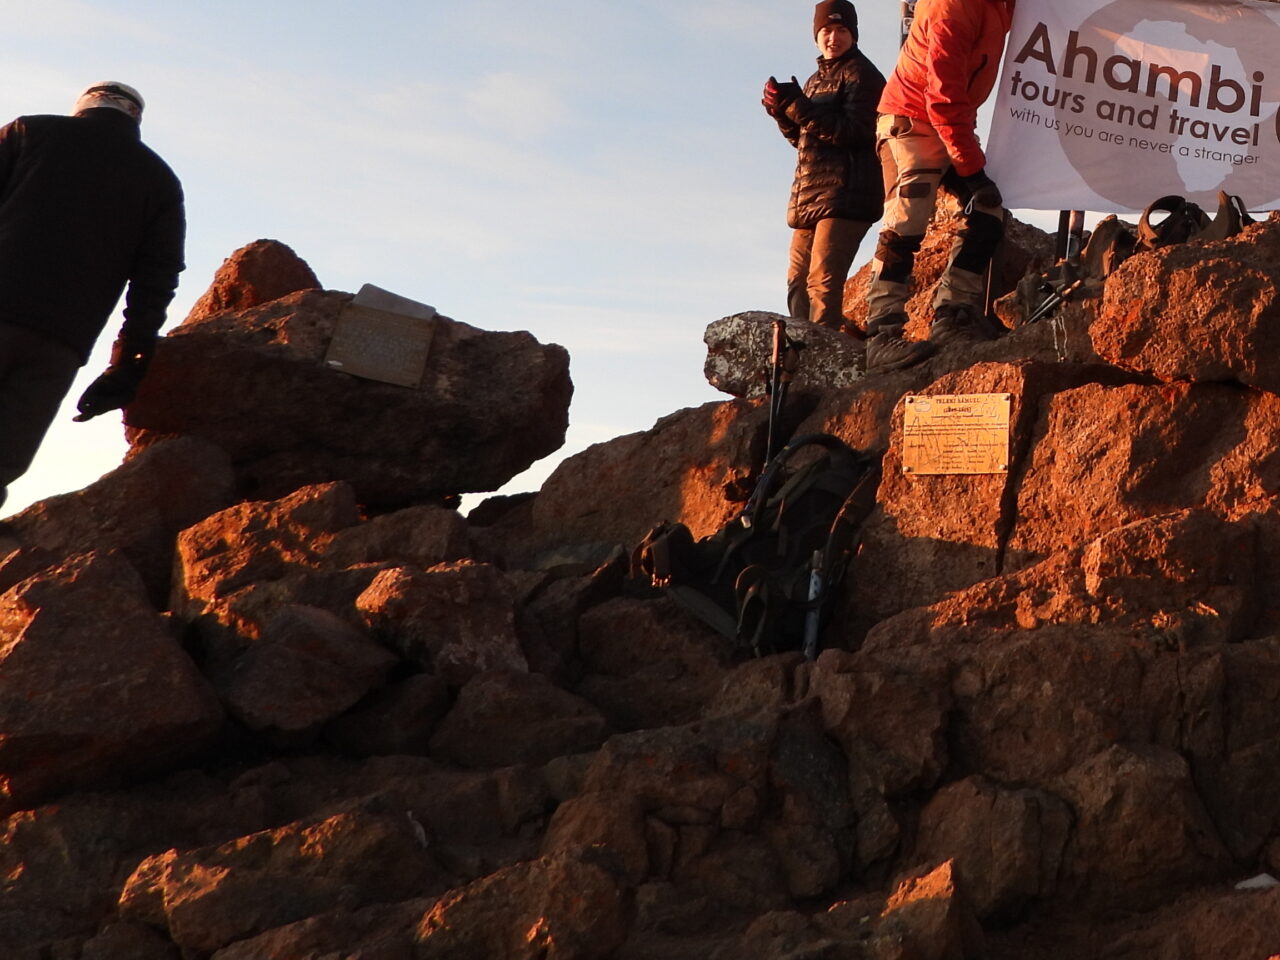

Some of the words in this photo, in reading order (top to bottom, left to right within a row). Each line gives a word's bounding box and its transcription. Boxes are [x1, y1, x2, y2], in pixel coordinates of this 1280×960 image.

[1014, 22, 1264, 117] Ahambi
[1010, 71, 1086, 113] tours
[1096, 99, 1159, 130] and
[1169, 109, 1259, 146] travel
[1010, 107, 1041, 126] with
[1044, 118, 1061, 131] us
[1065, 121, 1094, 139] you
[1098, 130, 1125, 145] are
[1129, 136, 1174, 154] never
[1178, 145, 1189, 157] a
[1194, 148, 1260, 166] stranger
